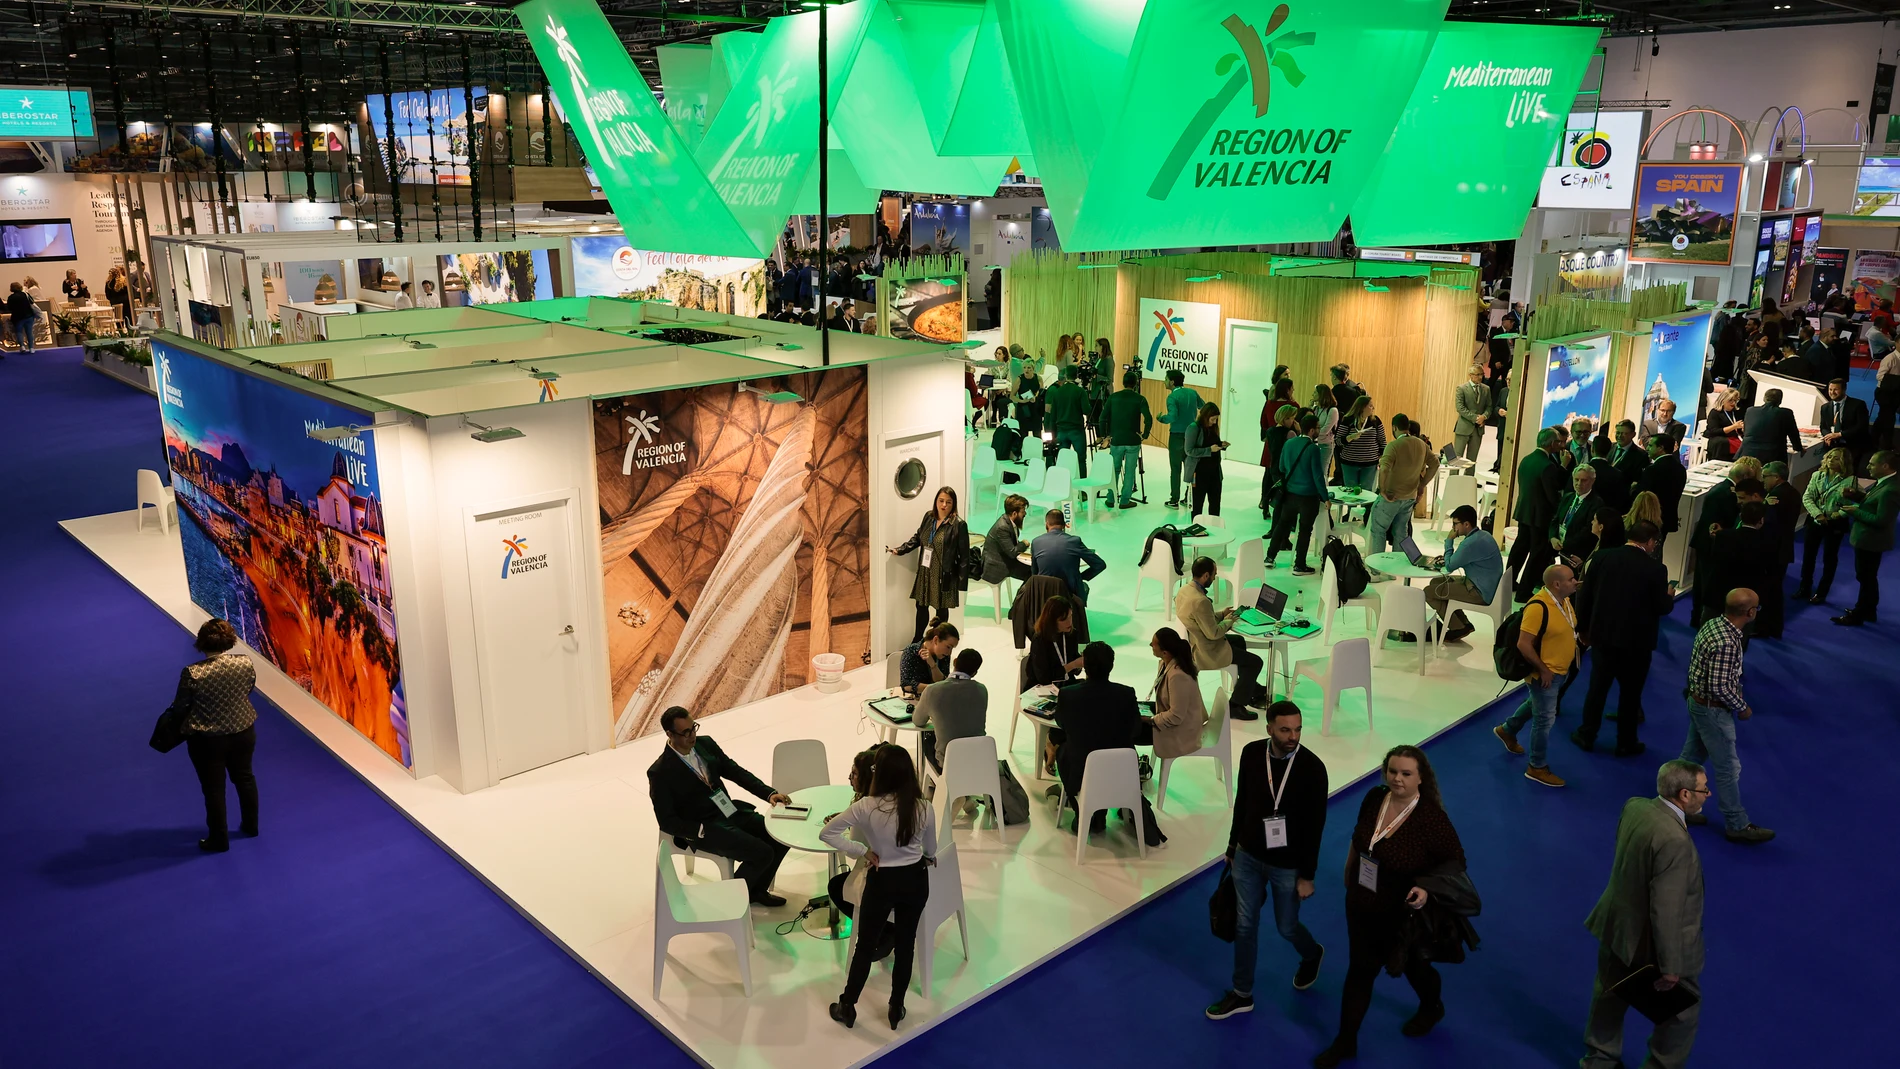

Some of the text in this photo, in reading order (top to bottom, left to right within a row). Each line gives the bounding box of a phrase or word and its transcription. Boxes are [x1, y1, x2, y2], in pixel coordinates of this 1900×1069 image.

[1444, 60, 1552, 90] Mediterranean
[1209, 129, 1352, 155] REGION OF
[1195, 160, 1332, 188] VALENCIA
[1656, 179, 1724, 192] SPAIN
[1586, 254, 1620, 269] COUNTRY
[1162, 348, 1208, 362] REGION OF
[1159, 359, 1208, 375] VALENCIA
[638, 442, 686, 458] REGION OF
[636, 452, 686, 469] VALENCIA
[499, 516, 524, 525] MEETING
[510, 561, 548, 575] VALENCIA
[512, 556, 538, 567] REGION
